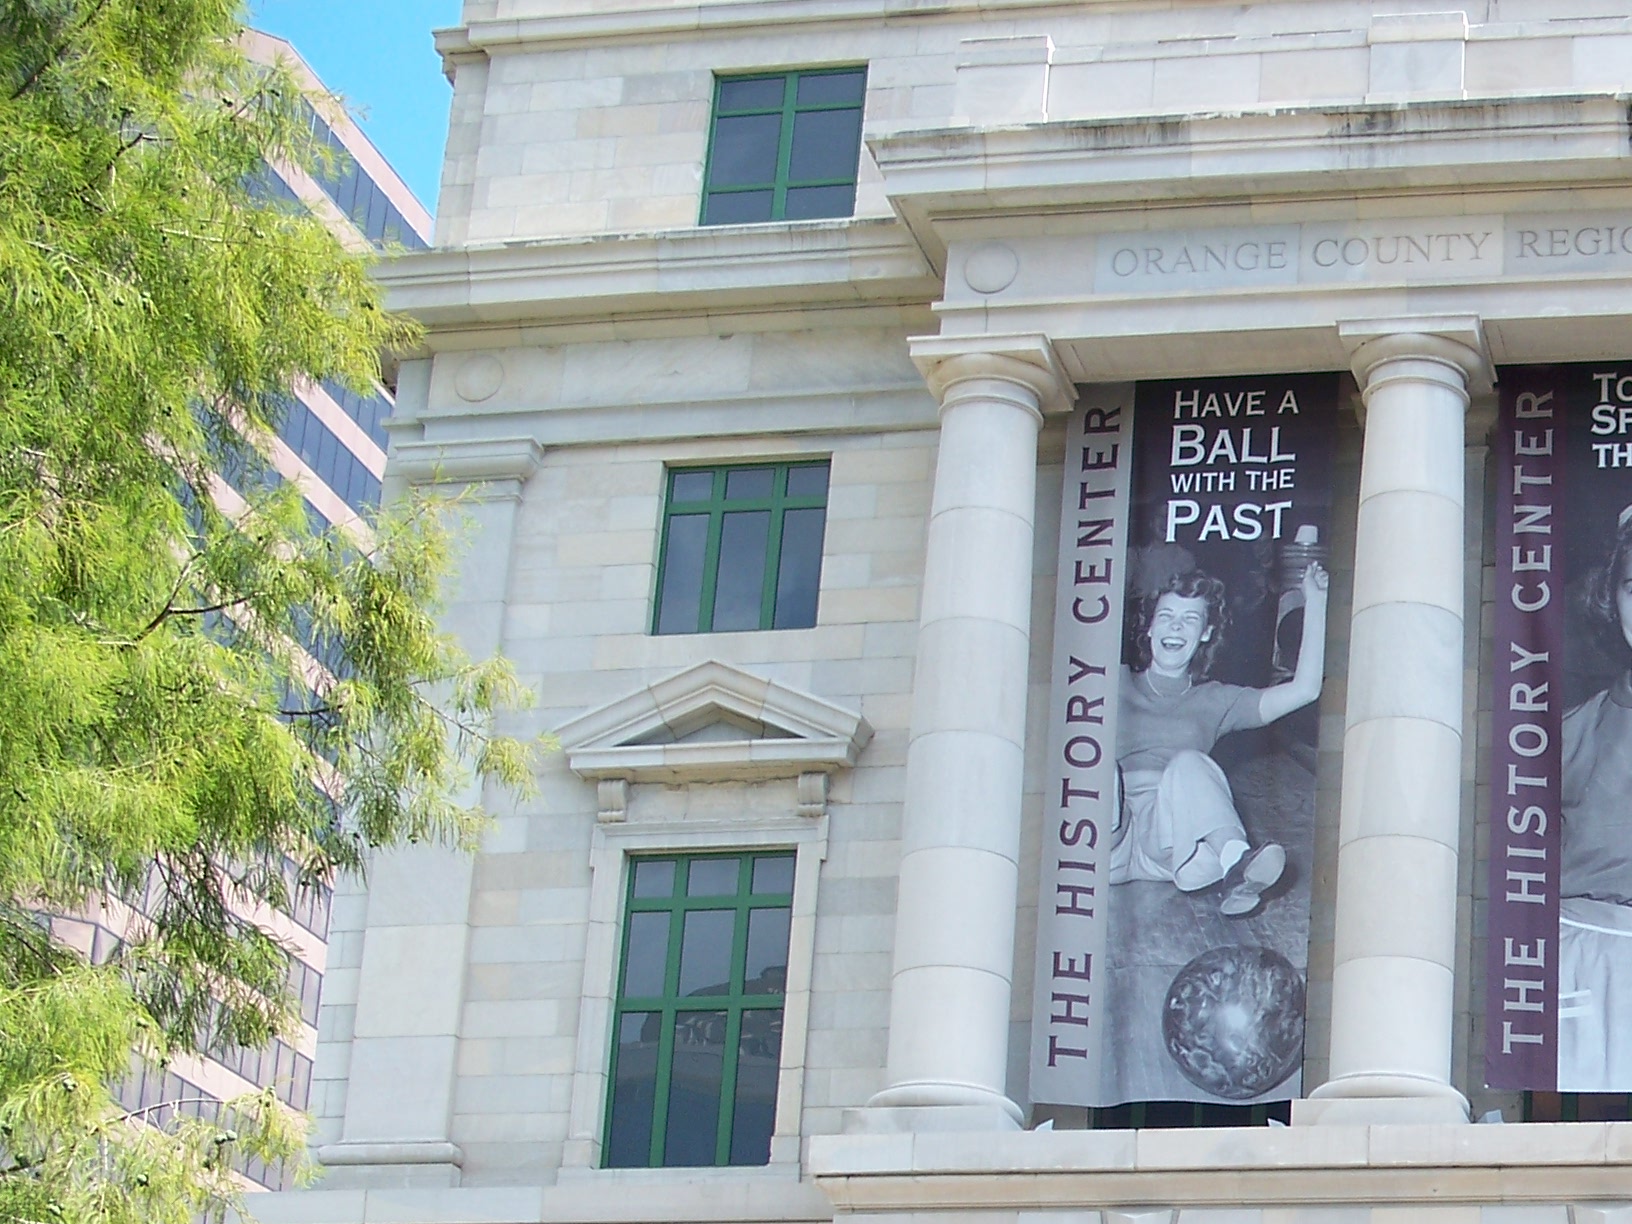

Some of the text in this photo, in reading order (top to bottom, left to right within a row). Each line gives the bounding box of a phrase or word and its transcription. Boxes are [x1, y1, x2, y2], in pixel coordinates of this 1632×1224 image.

[1112, 241, 1287, 278] ORANGE
[1312, 231, 1492, 267] COUNTY
[1173, 389, 1300, 420] HAVE A
[1169, 423, 1297, 467] BALL
[1170, 468, 1296, 494] WITH THE
[1165, 499, 1293, 544] PAST
[1047, 405, 1122, 1068] THE HISTORY CENTER
[1501, 390, 1554, 1055] THE HISTORY CENTER
